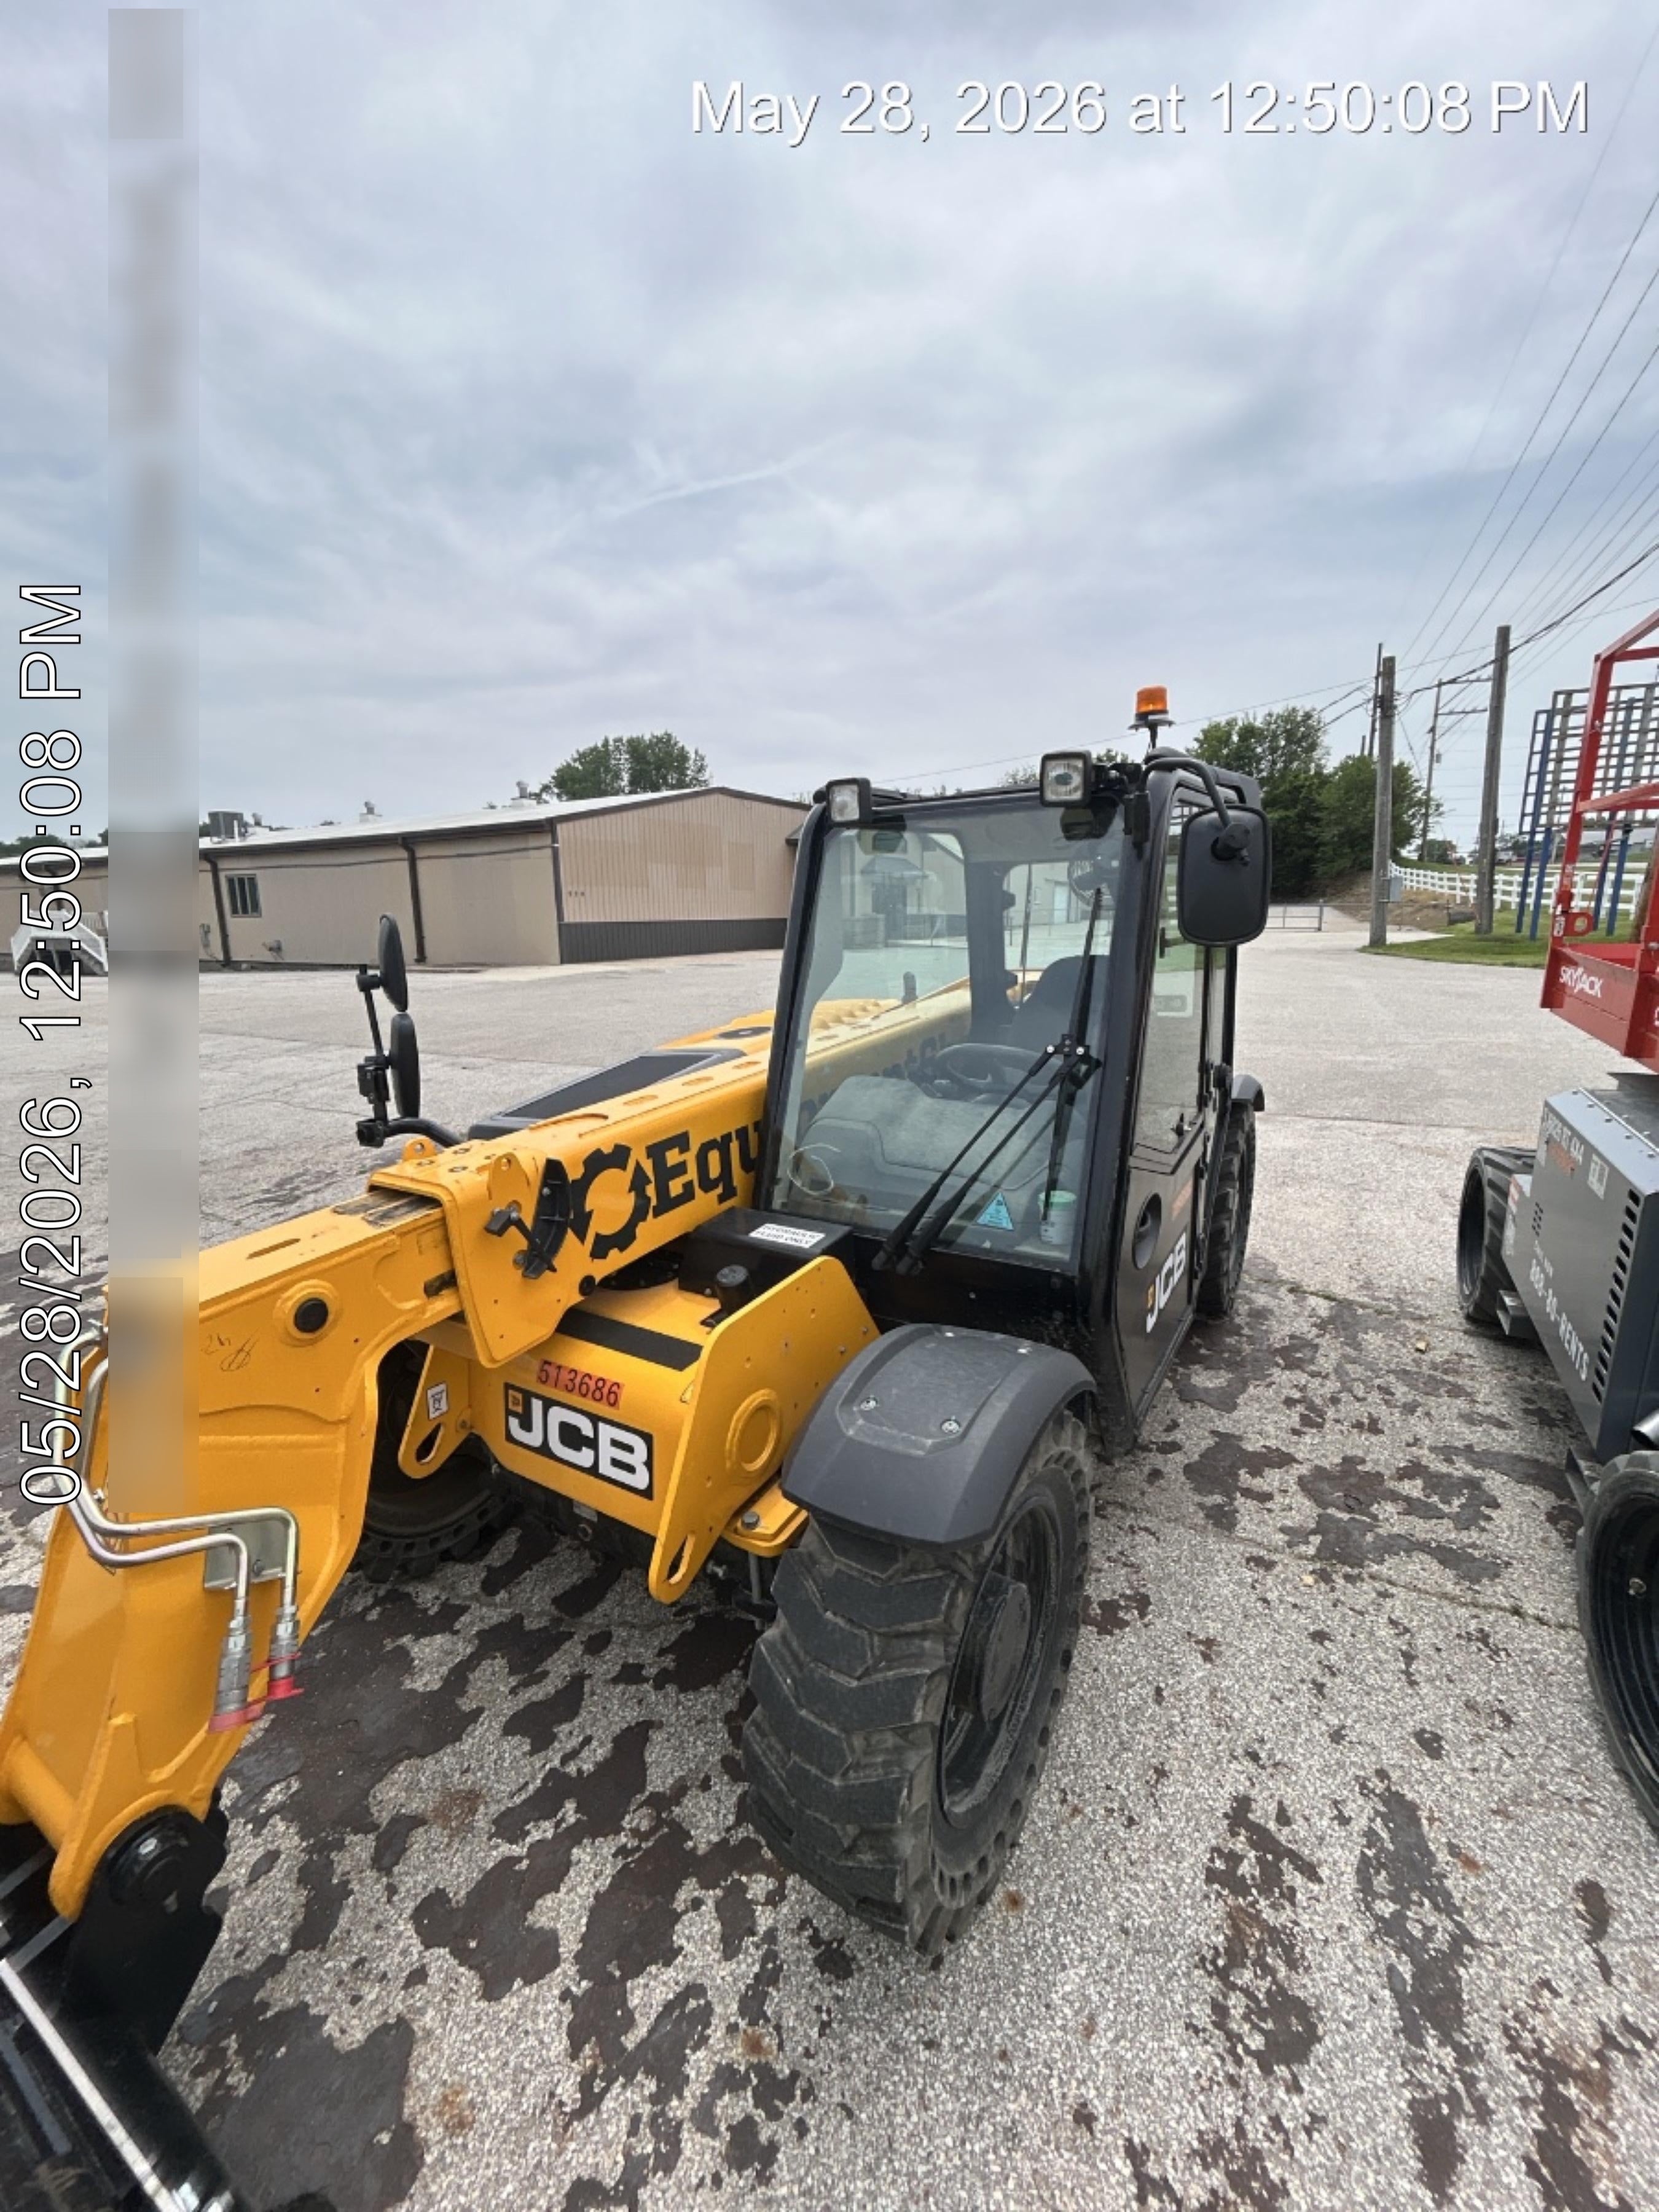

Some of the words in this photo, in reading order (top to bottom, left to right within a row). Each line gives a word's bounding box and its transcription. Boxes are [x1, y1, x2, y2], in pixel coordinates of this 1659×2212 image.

[1559, 965, 1603, 998] SKYJACK
[1146, 1231, 1185, 1333] JCB
[538, 1360, 621, 1407] 513686
[508, 1397, 649, 1491] JCB
